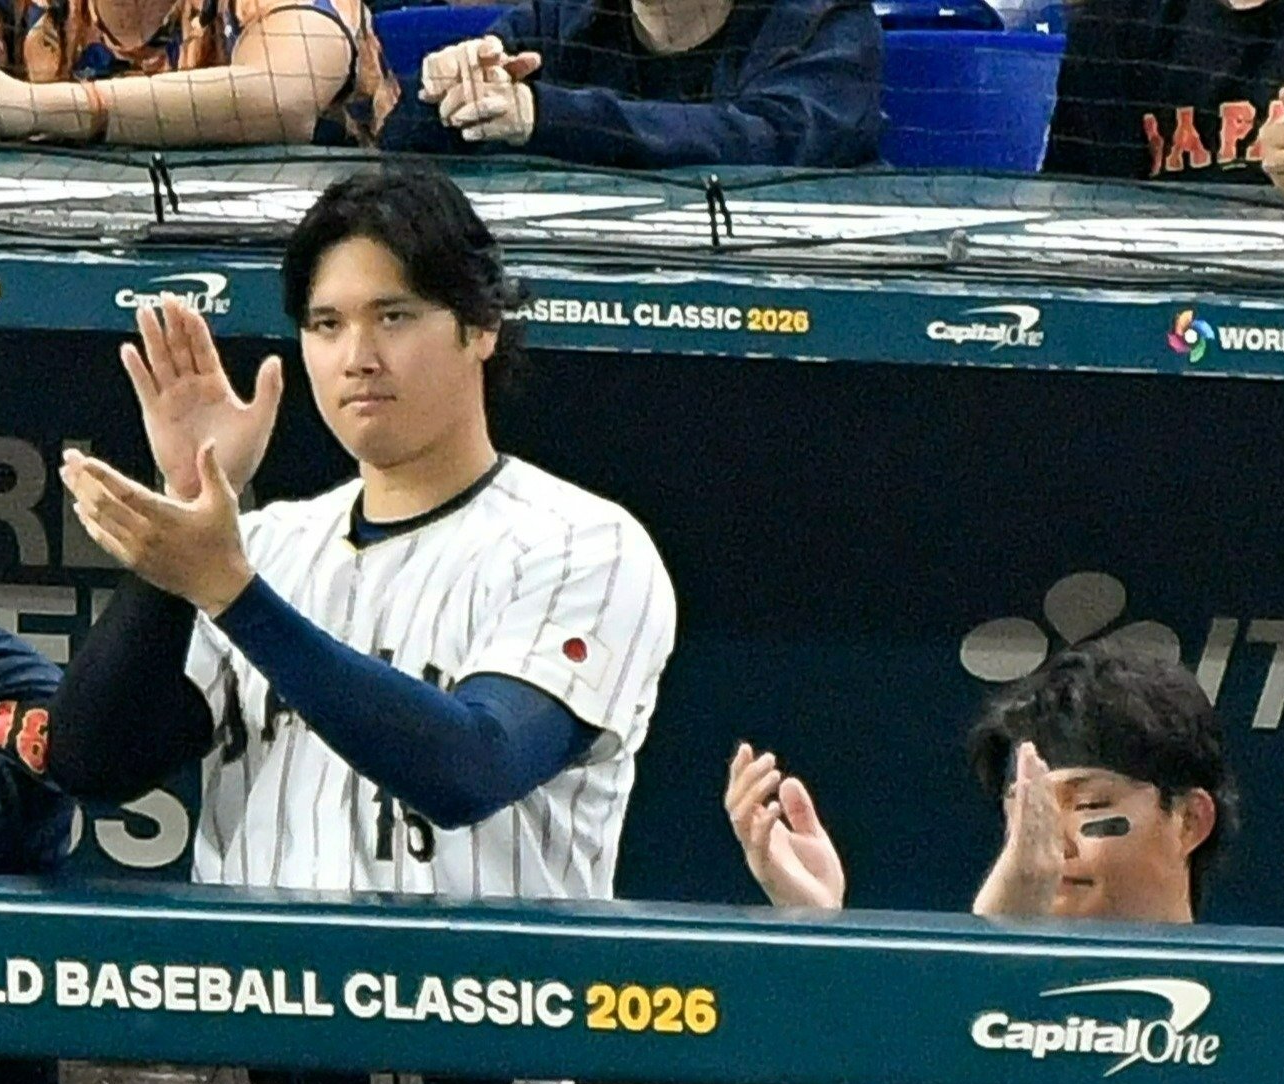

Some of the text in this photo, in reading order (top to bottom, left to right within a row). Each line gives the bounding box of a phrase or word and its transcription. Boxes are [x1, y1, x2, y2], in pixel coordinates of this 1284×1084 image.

[501, 300, 809, 333] ASEBALL CLASSIC 2026
[55, 960, 335, 1016] BASEBALL
[344, 972, 574, 1028] CLASSIC
[585, 983, 718, 1035] 2026
